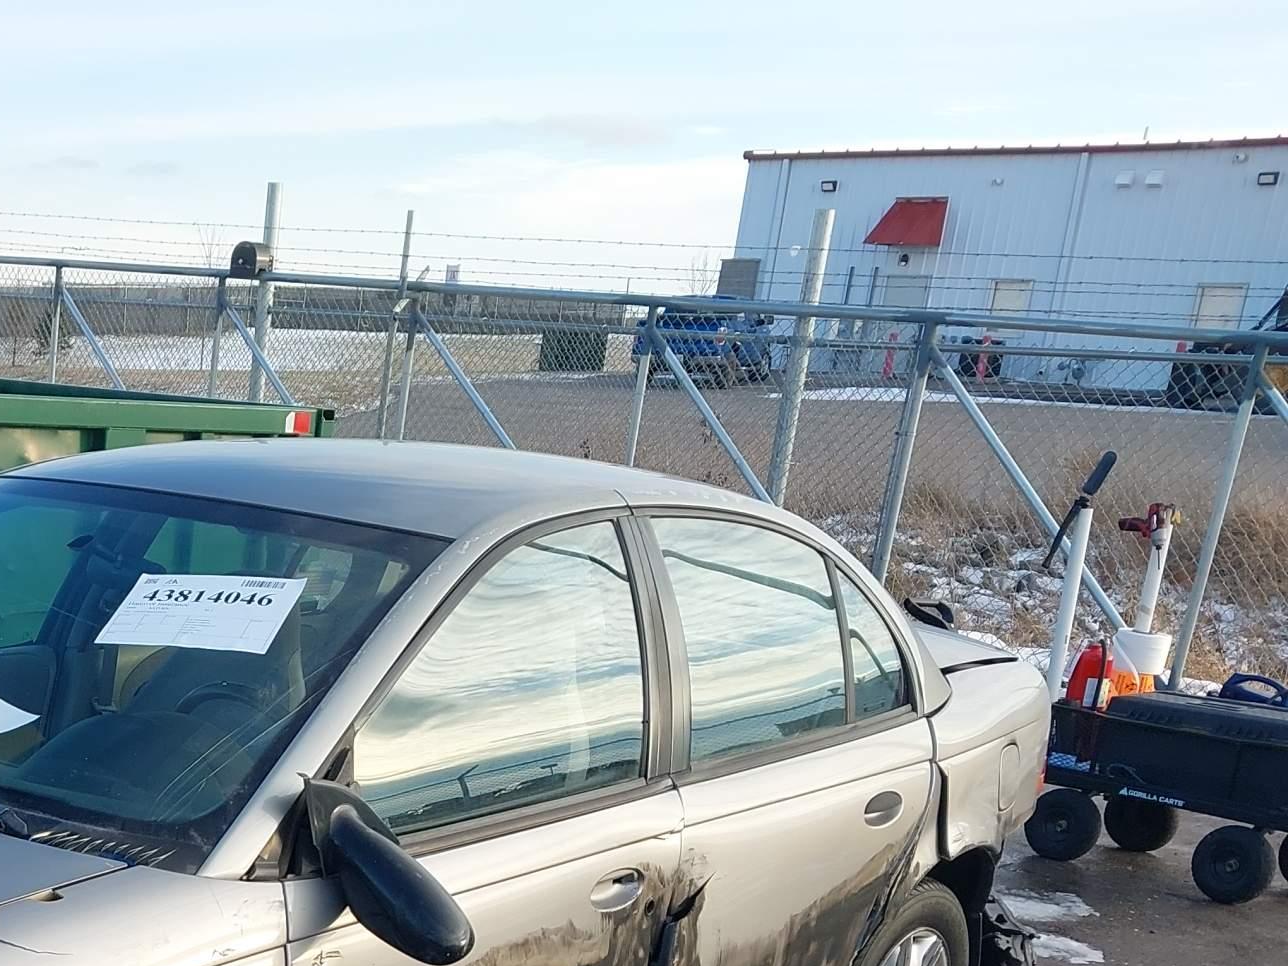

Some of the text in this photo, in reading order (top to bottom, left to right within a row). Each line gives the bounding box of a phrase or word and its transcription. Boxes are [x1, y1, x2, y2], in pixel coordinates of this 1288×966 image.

[143, 589, 278, 607] 43814046
[1128, 789, 1185, 807] GORILLA CARTS
